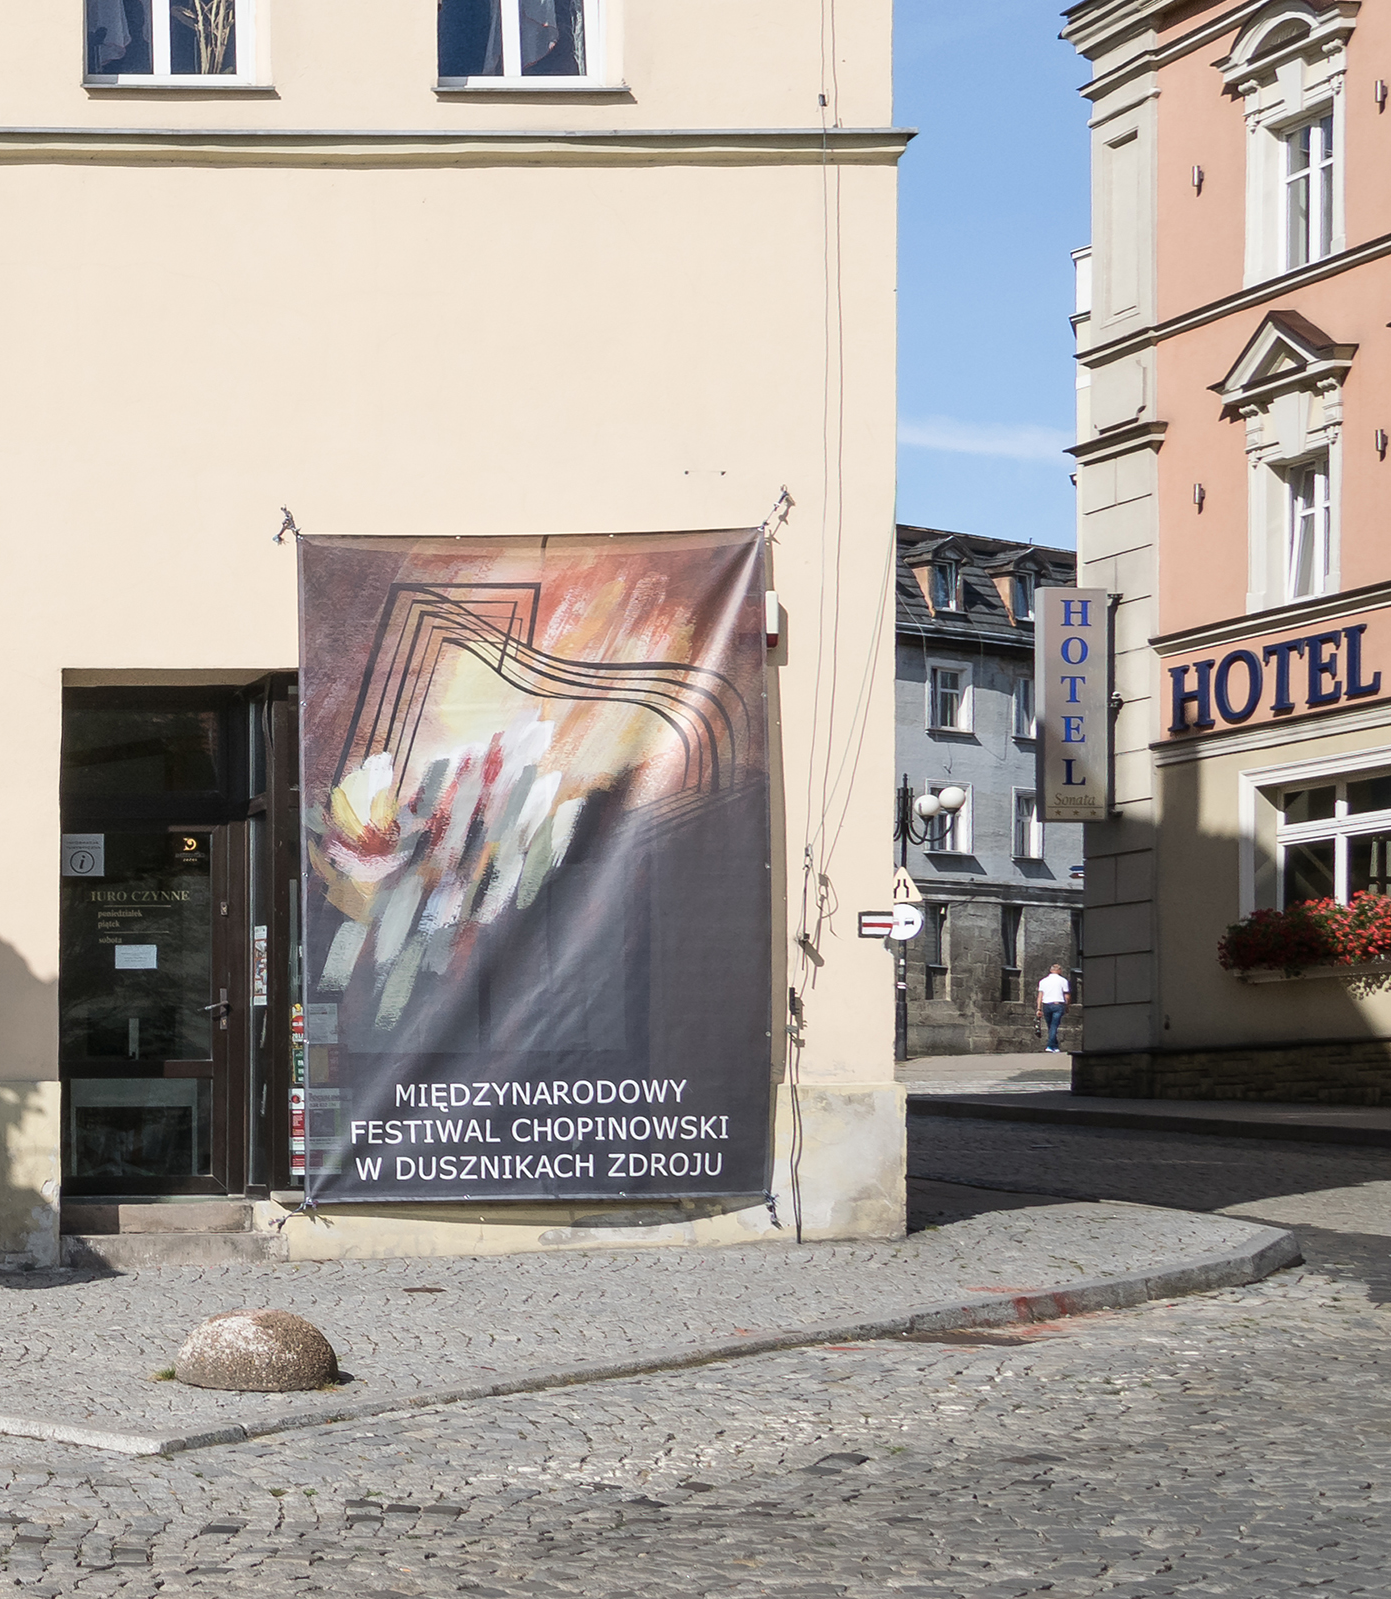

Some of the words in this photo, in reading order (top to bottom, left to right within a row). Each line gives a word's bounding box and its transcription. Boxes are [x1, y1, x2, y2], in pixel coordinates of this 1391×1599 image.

[1060, 599, 1092, 786] HOTEL
[1168, 623, 1382, 734] HOTEL
[1054, 792, 1097, 807] Sonata
[85, 890, 127, 902] IURO
[131, 890, 191, 902] CZYNNE
[98, 936, 123, 944] sobota
[394, 1078, 687, 1113] MIĘDZYNARODOWY
[350, 1118, 501, 1144] FESTIWAL
[511, 1115, 729, 1143] CHOPINOWSKI
[355, 1156, 383, 1181] W
[396, 1153, 595, 1181] DUSZNIKACH
[608, 1151, 723, 1178] ZDROJU
